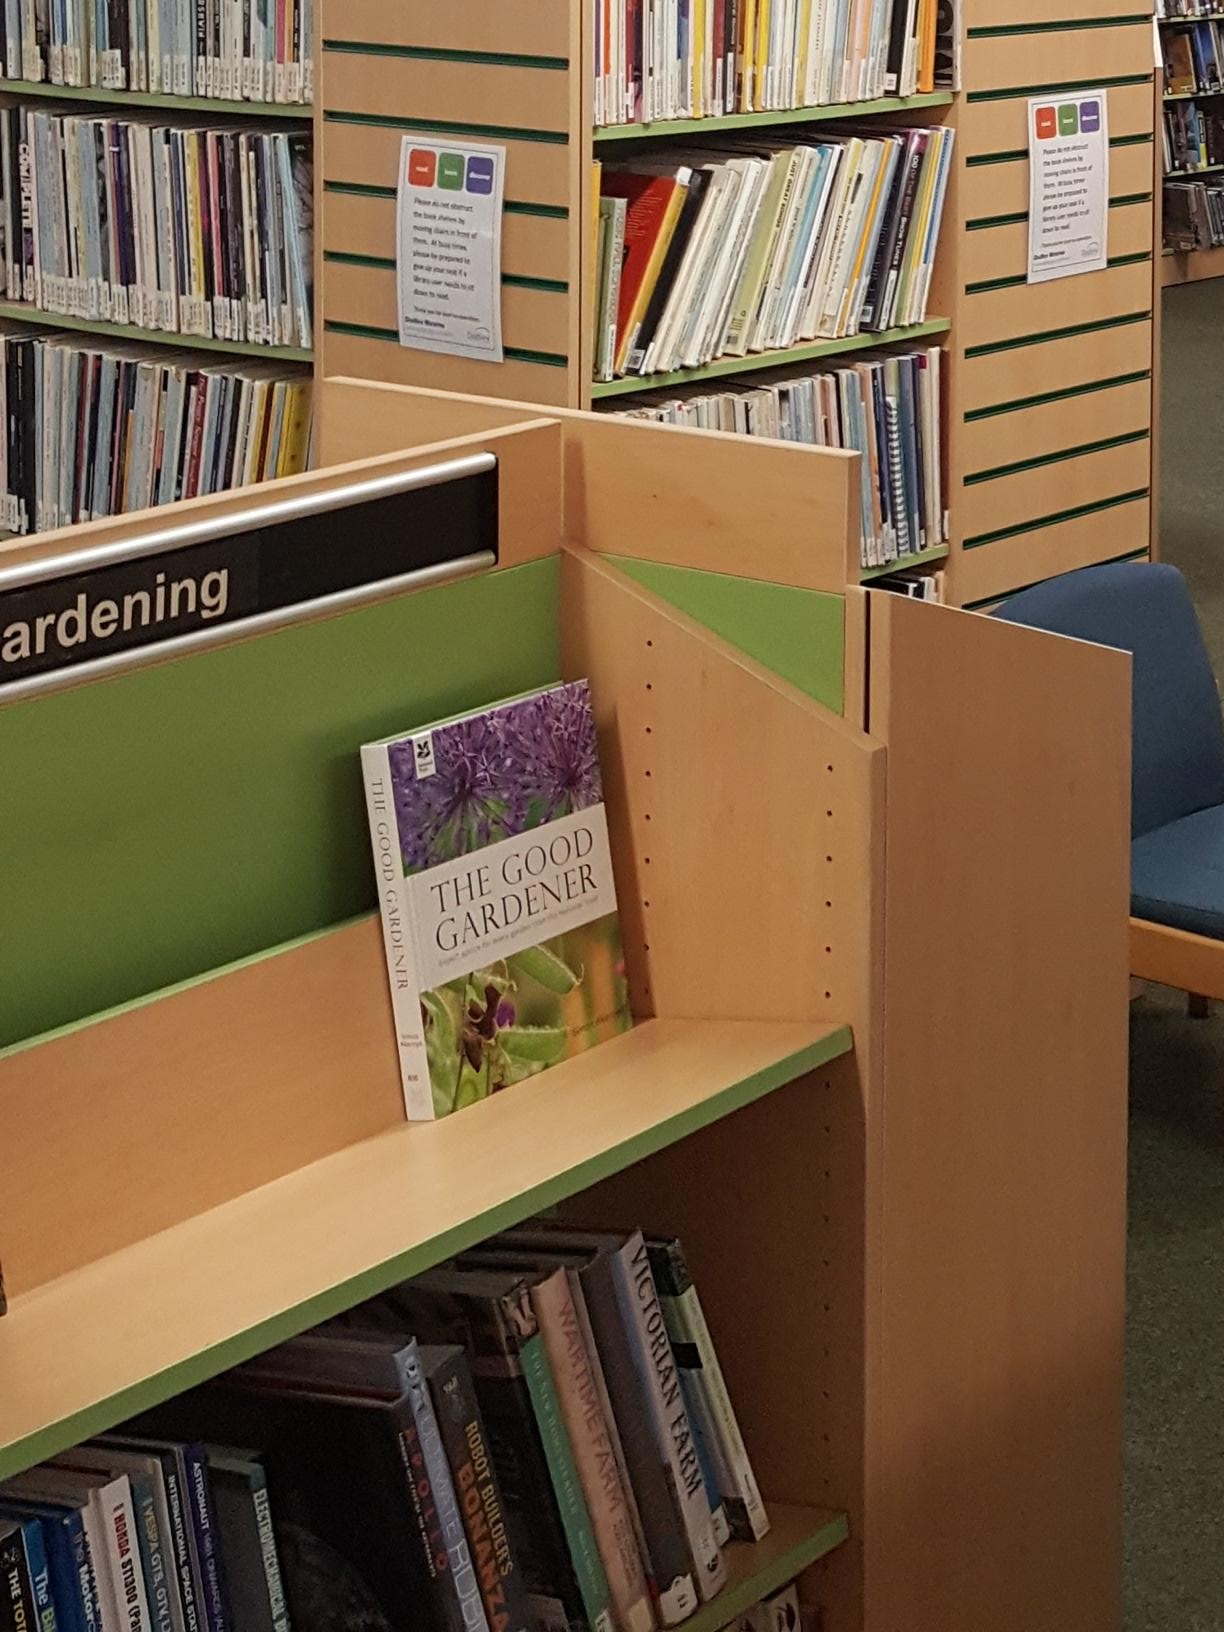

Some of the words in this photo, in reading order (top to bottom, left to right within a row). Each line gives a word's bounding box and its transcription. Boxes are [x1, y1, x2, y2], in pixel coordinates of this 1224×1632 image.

[2, 568, 229, 663] ardening
[370, 778, 387, 814] THE
[376, 821, 395, 882] GOOD
[430, 865, 492, 913] THE
[502, 827, 593, 886] GOOD
[384, 887, 410, 992] GARDENER
[436, 863, 598, 952] GARDENER
[557, 1300, 604, 1432] WARTIME
[590, 1432, 624, 1512] FARM
[629, 1244, 681, 1409] VICTORIAN
[670, 1415, 702, 1499] FARM
[112, 1513, 131, 1558] HONDA
[142, 1505, 160, 1553] VESPA
[191, 1461, 210, 1530] ASTRONAUT
[465, 1420, 491, 1481] ROBOT
[480, 1484, 514, 1577] BUILDER'S
[120, 1559, 139, 1604] ST1300
[167, 1475, 187, 1563] INTERNATIONAL
[180, 1566, 194, 1604] SPACE
[251, 1488, 286, 1619] ELECTROMECHANICAL
[456, 1462, 511, 1632] BONANZA
[7, 1568, 22, 1599] THE
[34, 1567, 50, 1605] The
